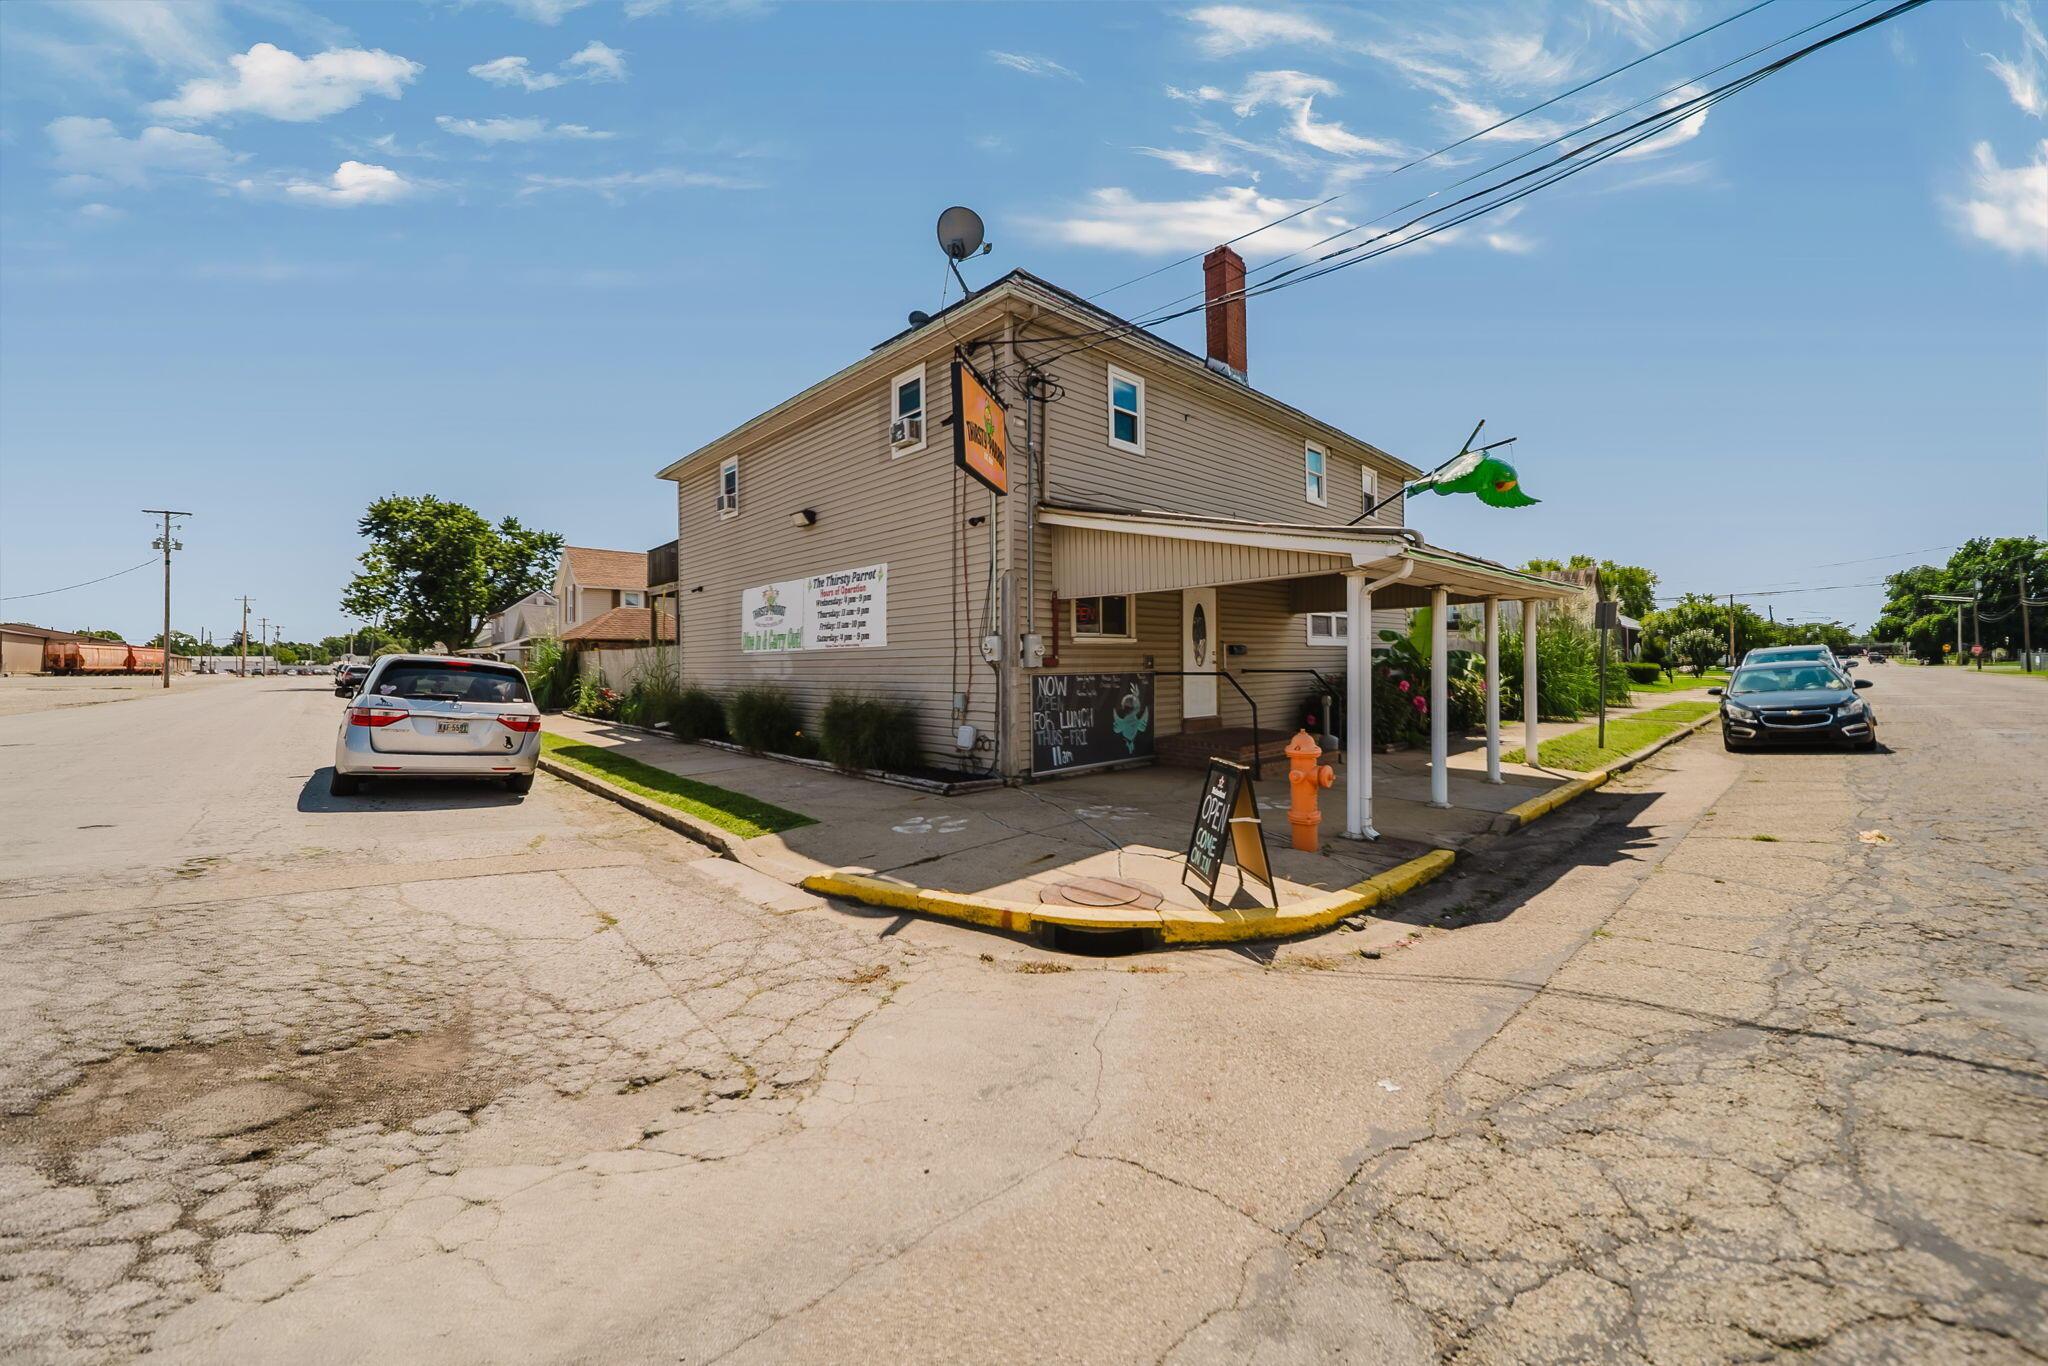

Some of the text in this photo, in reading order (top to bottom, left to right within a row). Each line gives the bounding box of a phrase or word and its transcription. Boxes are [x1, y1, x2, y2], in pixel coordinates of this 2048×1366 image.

[813, 569, 877, 589] The Thirsty Parrot
[820, 589, 834, 598] Hours
[841, 584, 866, 595] Operation
[1038, 675, 1067, 697] NOW
[1033, 707, 1094, 731] FOR LUNCH
[1202, 794, 1231, 834] OPEN
[1195, 827, 1218, 857] COME
[1190, 846, 1212, 875] ON IN
